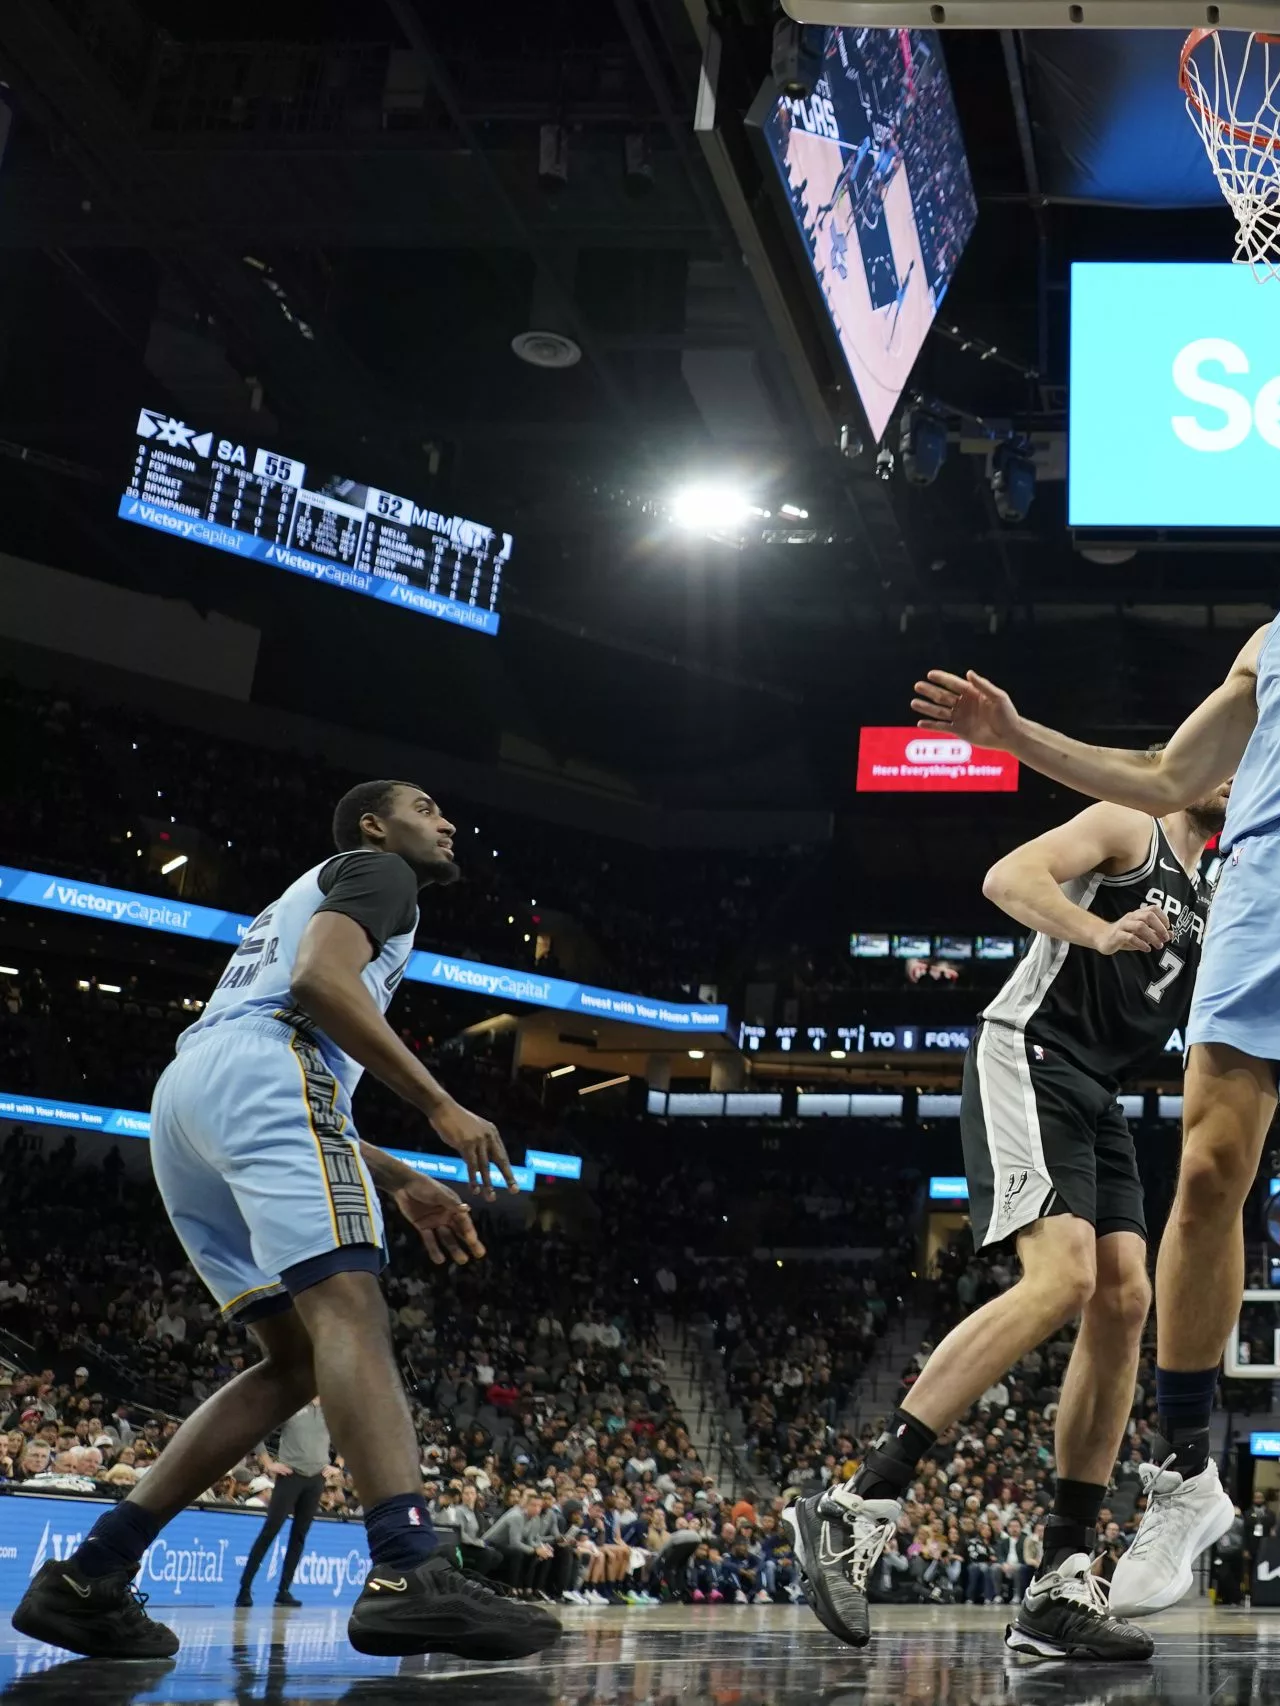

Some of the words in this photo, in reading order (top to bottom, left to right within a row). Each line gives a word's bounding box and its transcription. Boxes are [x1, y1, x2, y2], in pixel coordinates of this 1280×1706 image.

[218, 440, 246, 466] SA
[265, 456, 291, 481] 55
[378, 495, 402, 518] 52
[412, 507, 451, 534] MEM
[872, 765, 898, 776] Here
[900, 764, 965, 778] Everything's
[57, 885, 189, 928] VictoryCapital
[443, 963, 549, 999] VictoryCapital
[1144, 948, 1185, 1003] 7
[581, 992, 612, 1010] Invest
[613, 1000, 634, 1014] with
[636, 1004, 658, 1019] Your
[659, 1008, 689, 1023] Home
[691, 1009, 719, 1024] Team
[870, 1031, 895, 1047] TO
[925, 1031, 970, 1048] FG%
